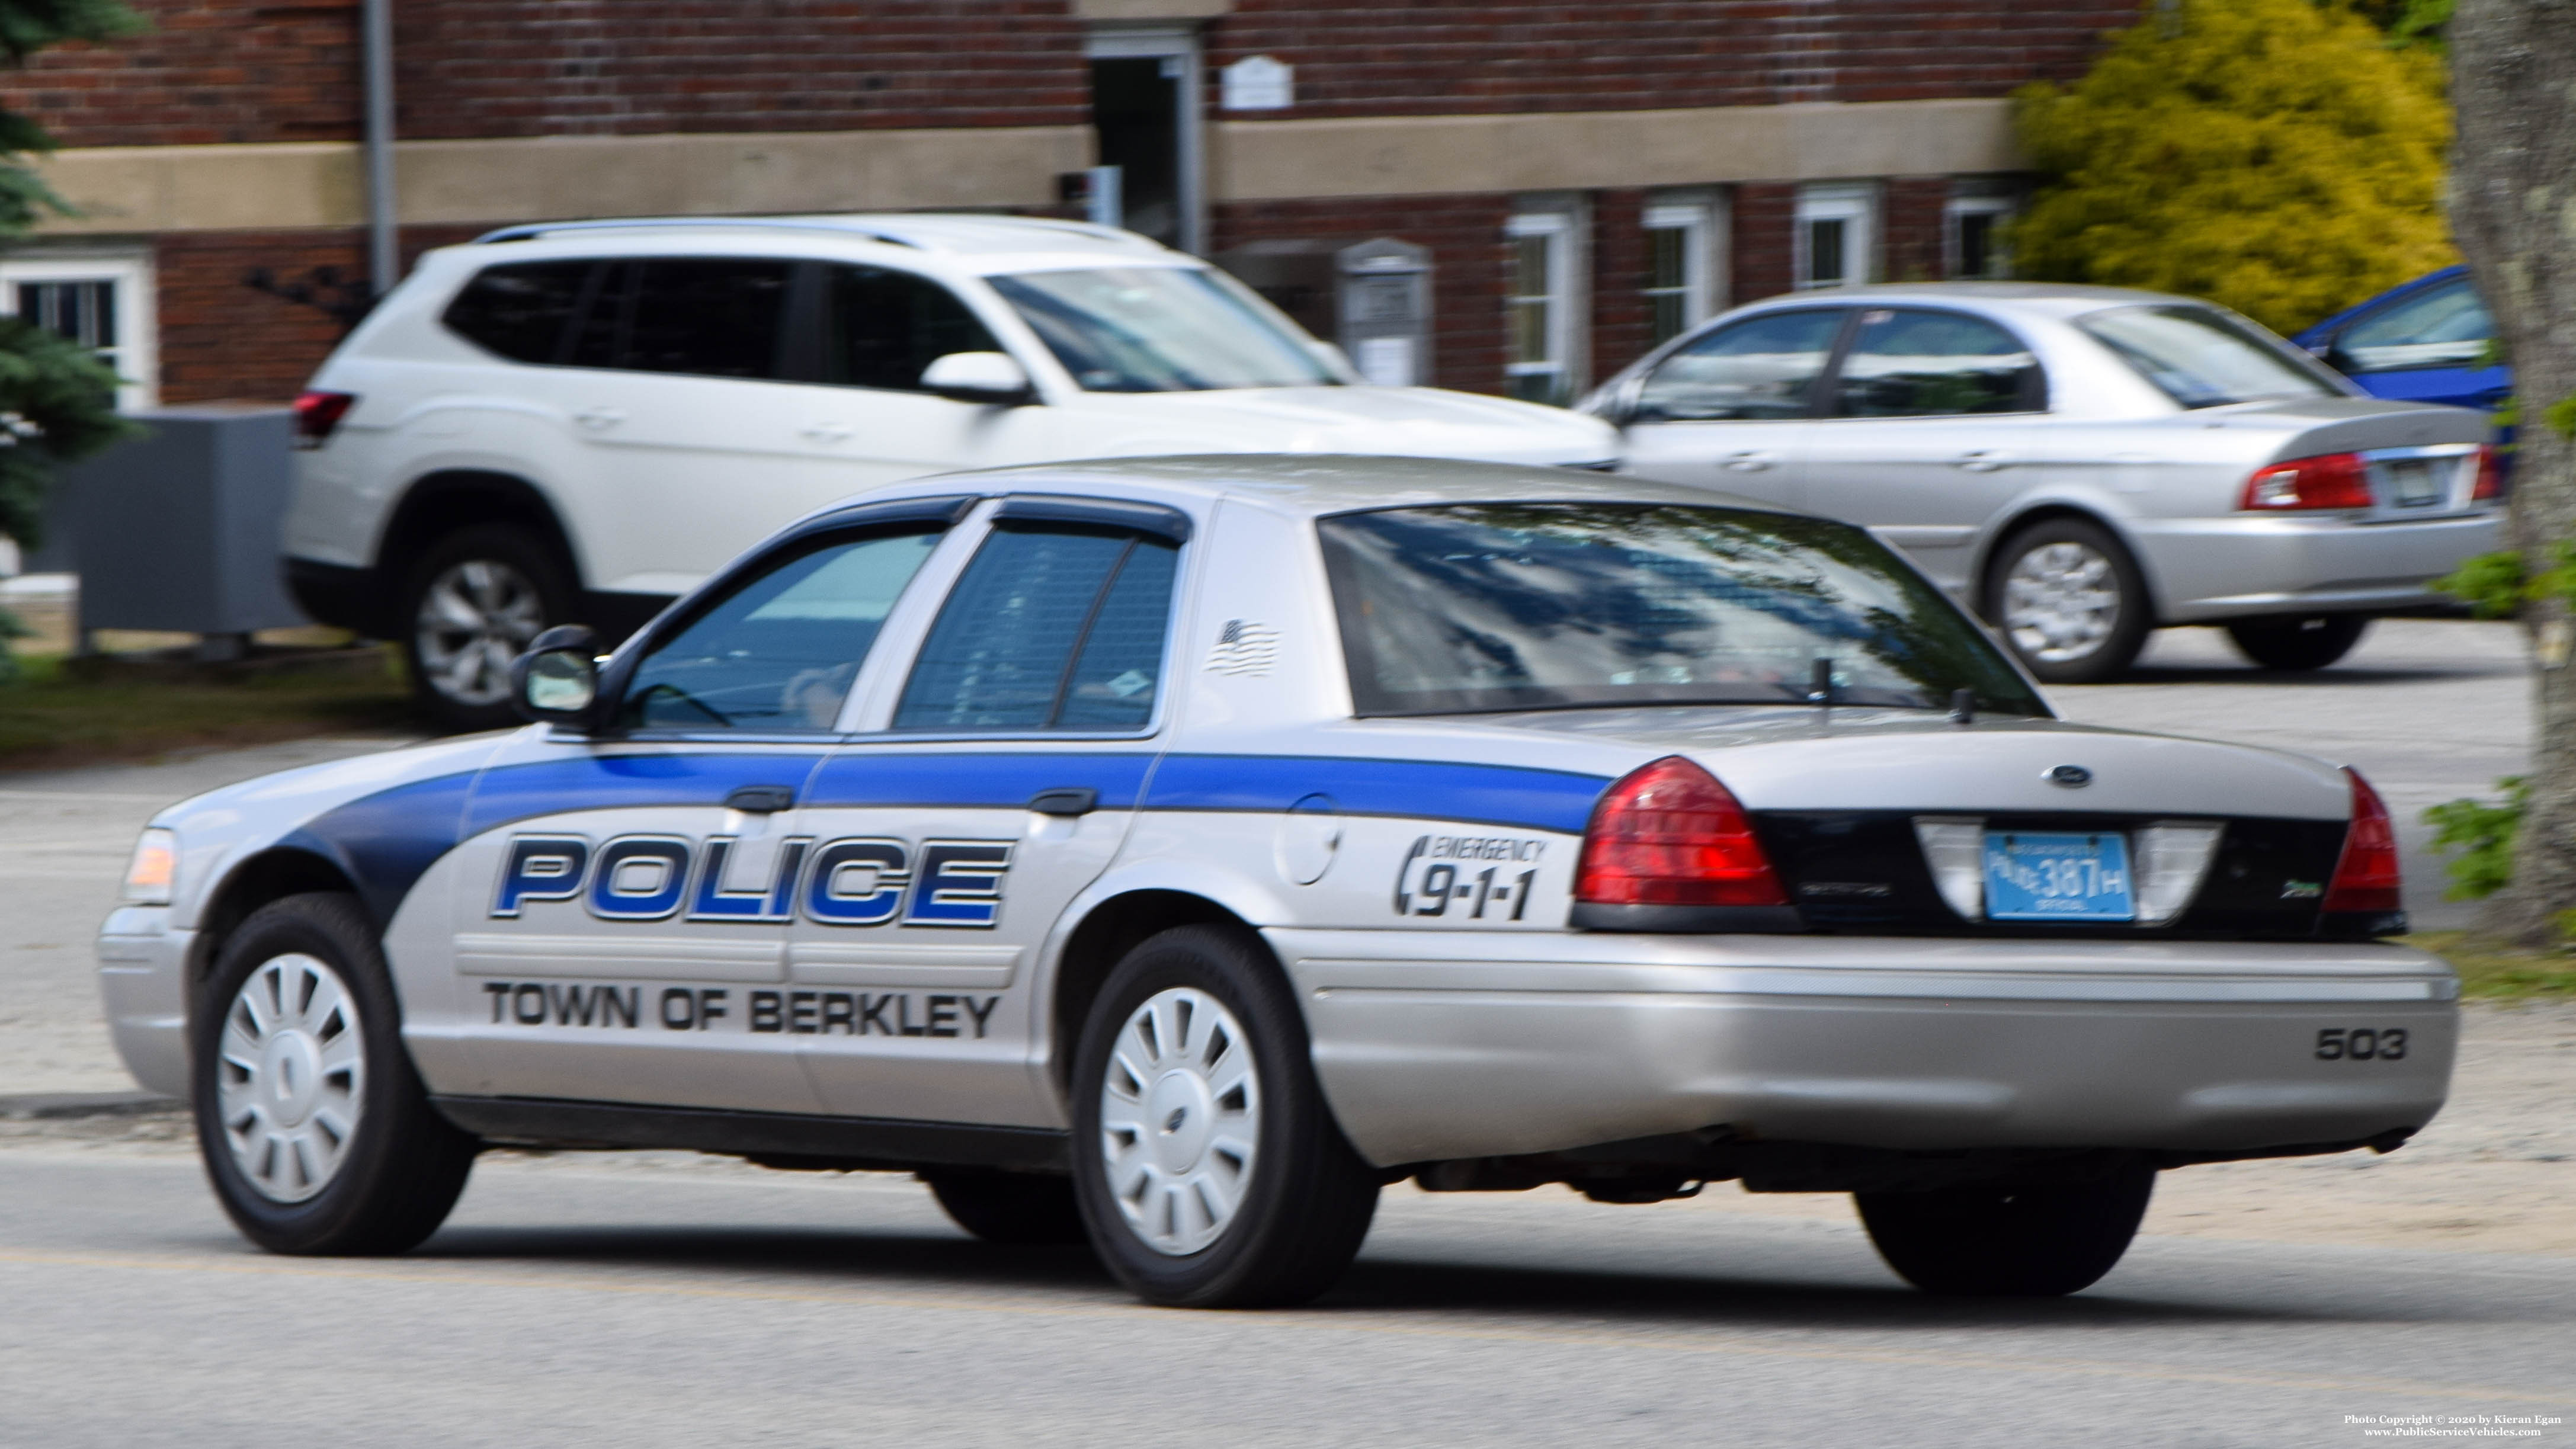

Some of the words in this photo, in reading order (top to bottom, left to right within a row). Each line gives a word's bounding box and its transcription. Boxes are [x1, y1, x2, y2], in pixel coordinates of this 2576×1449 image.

[1432, 835, 1547, 862] EMERGENCY
[488, 832, 1019, 929] POLICE
[1415, 863, 1539, 921] 9-1-1
[485, 982, 639, 1028] TOWN
[661, 988, 730, 1030] OF
[749, 990, 999, 1037] BERKLEY
[2315, 1028, 2408, 1060] 503
